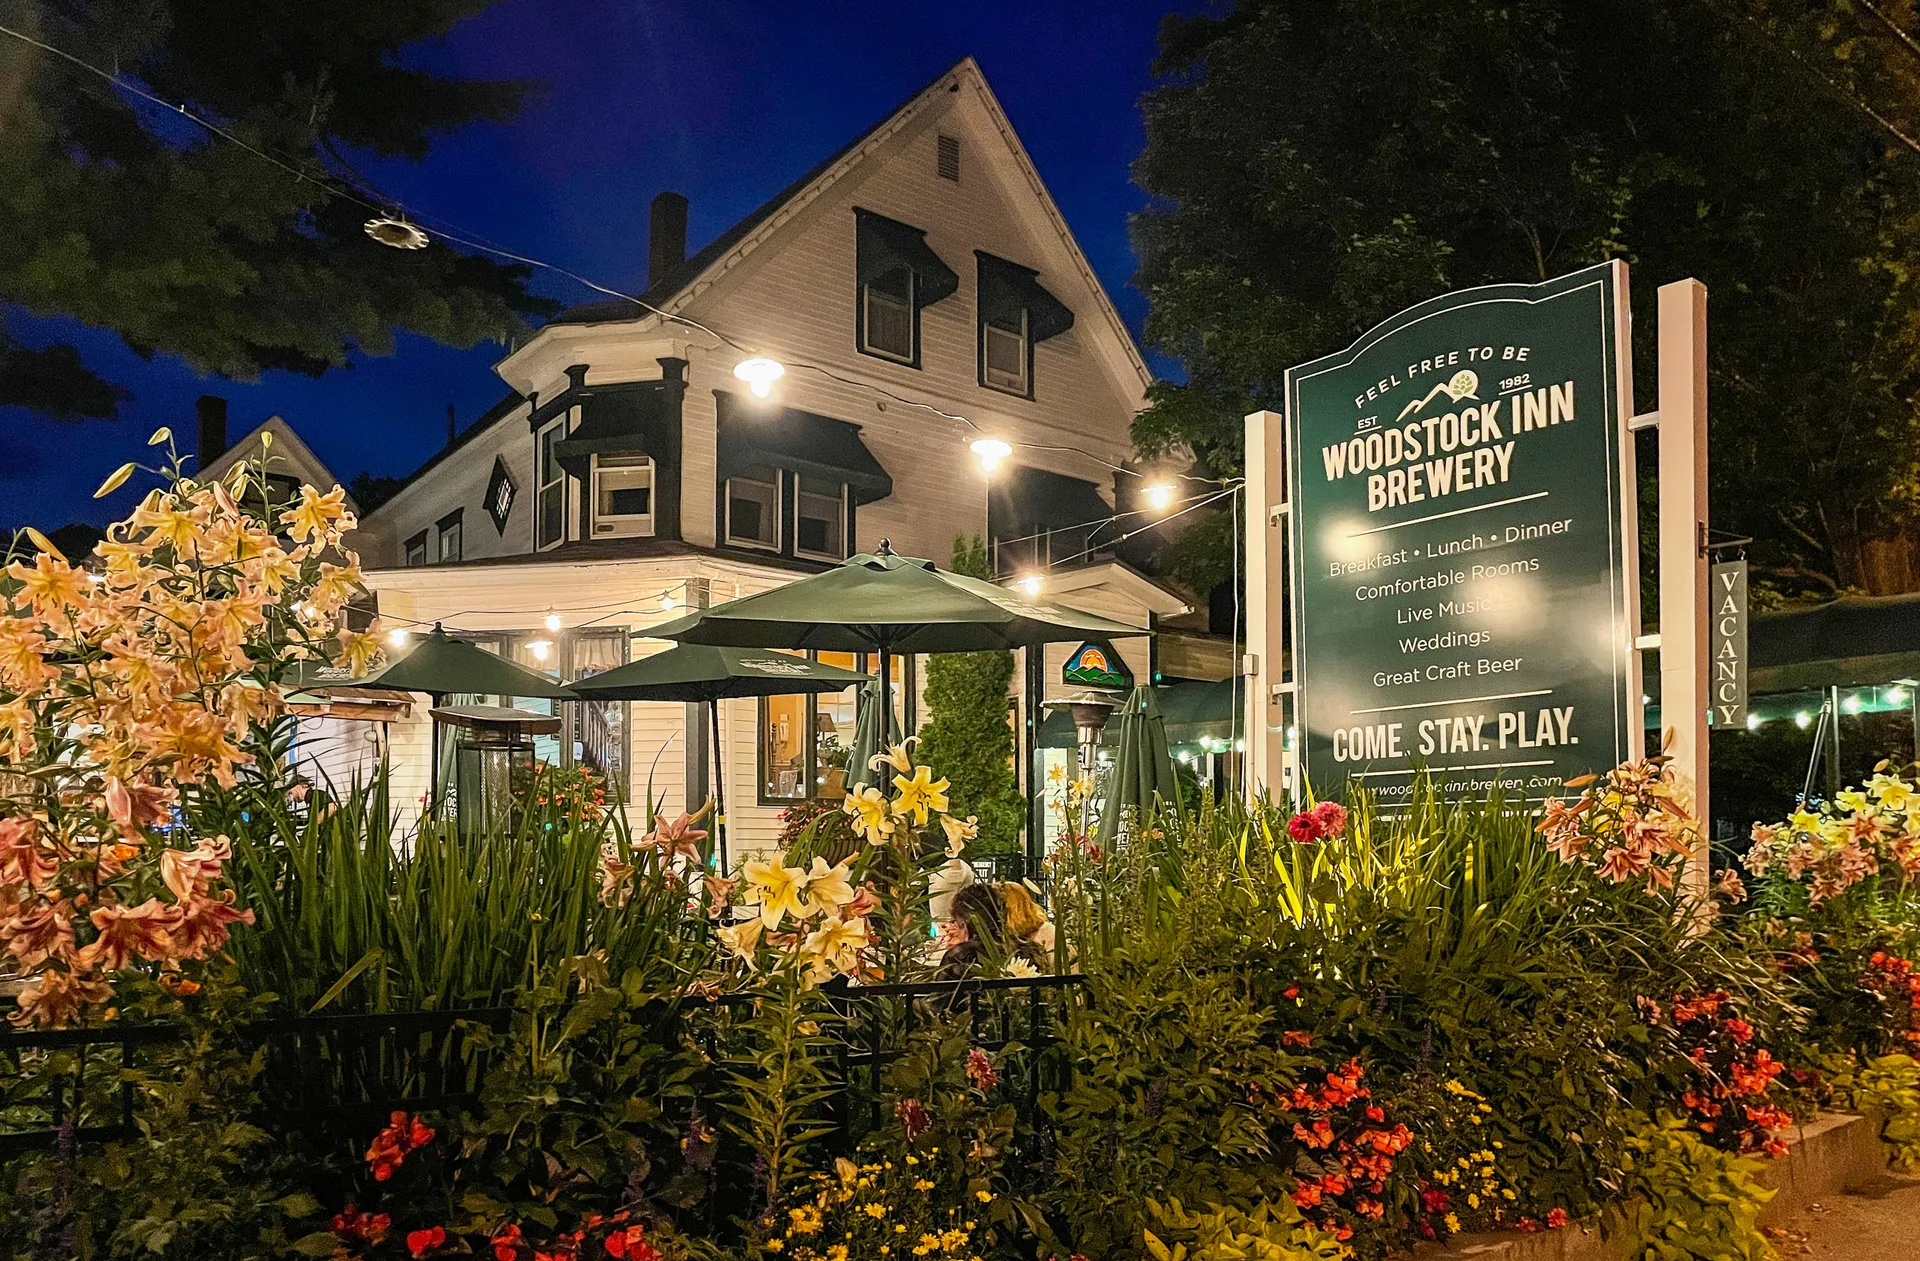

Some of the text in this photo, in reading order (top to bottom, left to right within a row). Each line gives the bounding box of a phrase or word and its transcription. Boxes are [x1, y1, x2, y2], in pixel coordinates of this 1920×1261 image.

[1355, 346, 1531, 409] FEEL FREE TO BE
[1357, 373, 1531, 430] EST 1982
[1322, 380, 1575, 481] WOODSTOCK INN
[1368, 440, 1516, 512] BREWERY
[1330, 518, 1573, 577] Breakfast Lunch Dinner
[1355, 558, 1540, 601] Comfortable Rooms
[1397, 597, 1493, 624] Live Music
[1398, 630, 1491, 654] Weddings
[1717, 571, 1740, 725] VACANCY
[1373, 656, 1523, 687] Great Craft Beer
[1332, 706, 1579, 762] COME. STAY. PLAY.
